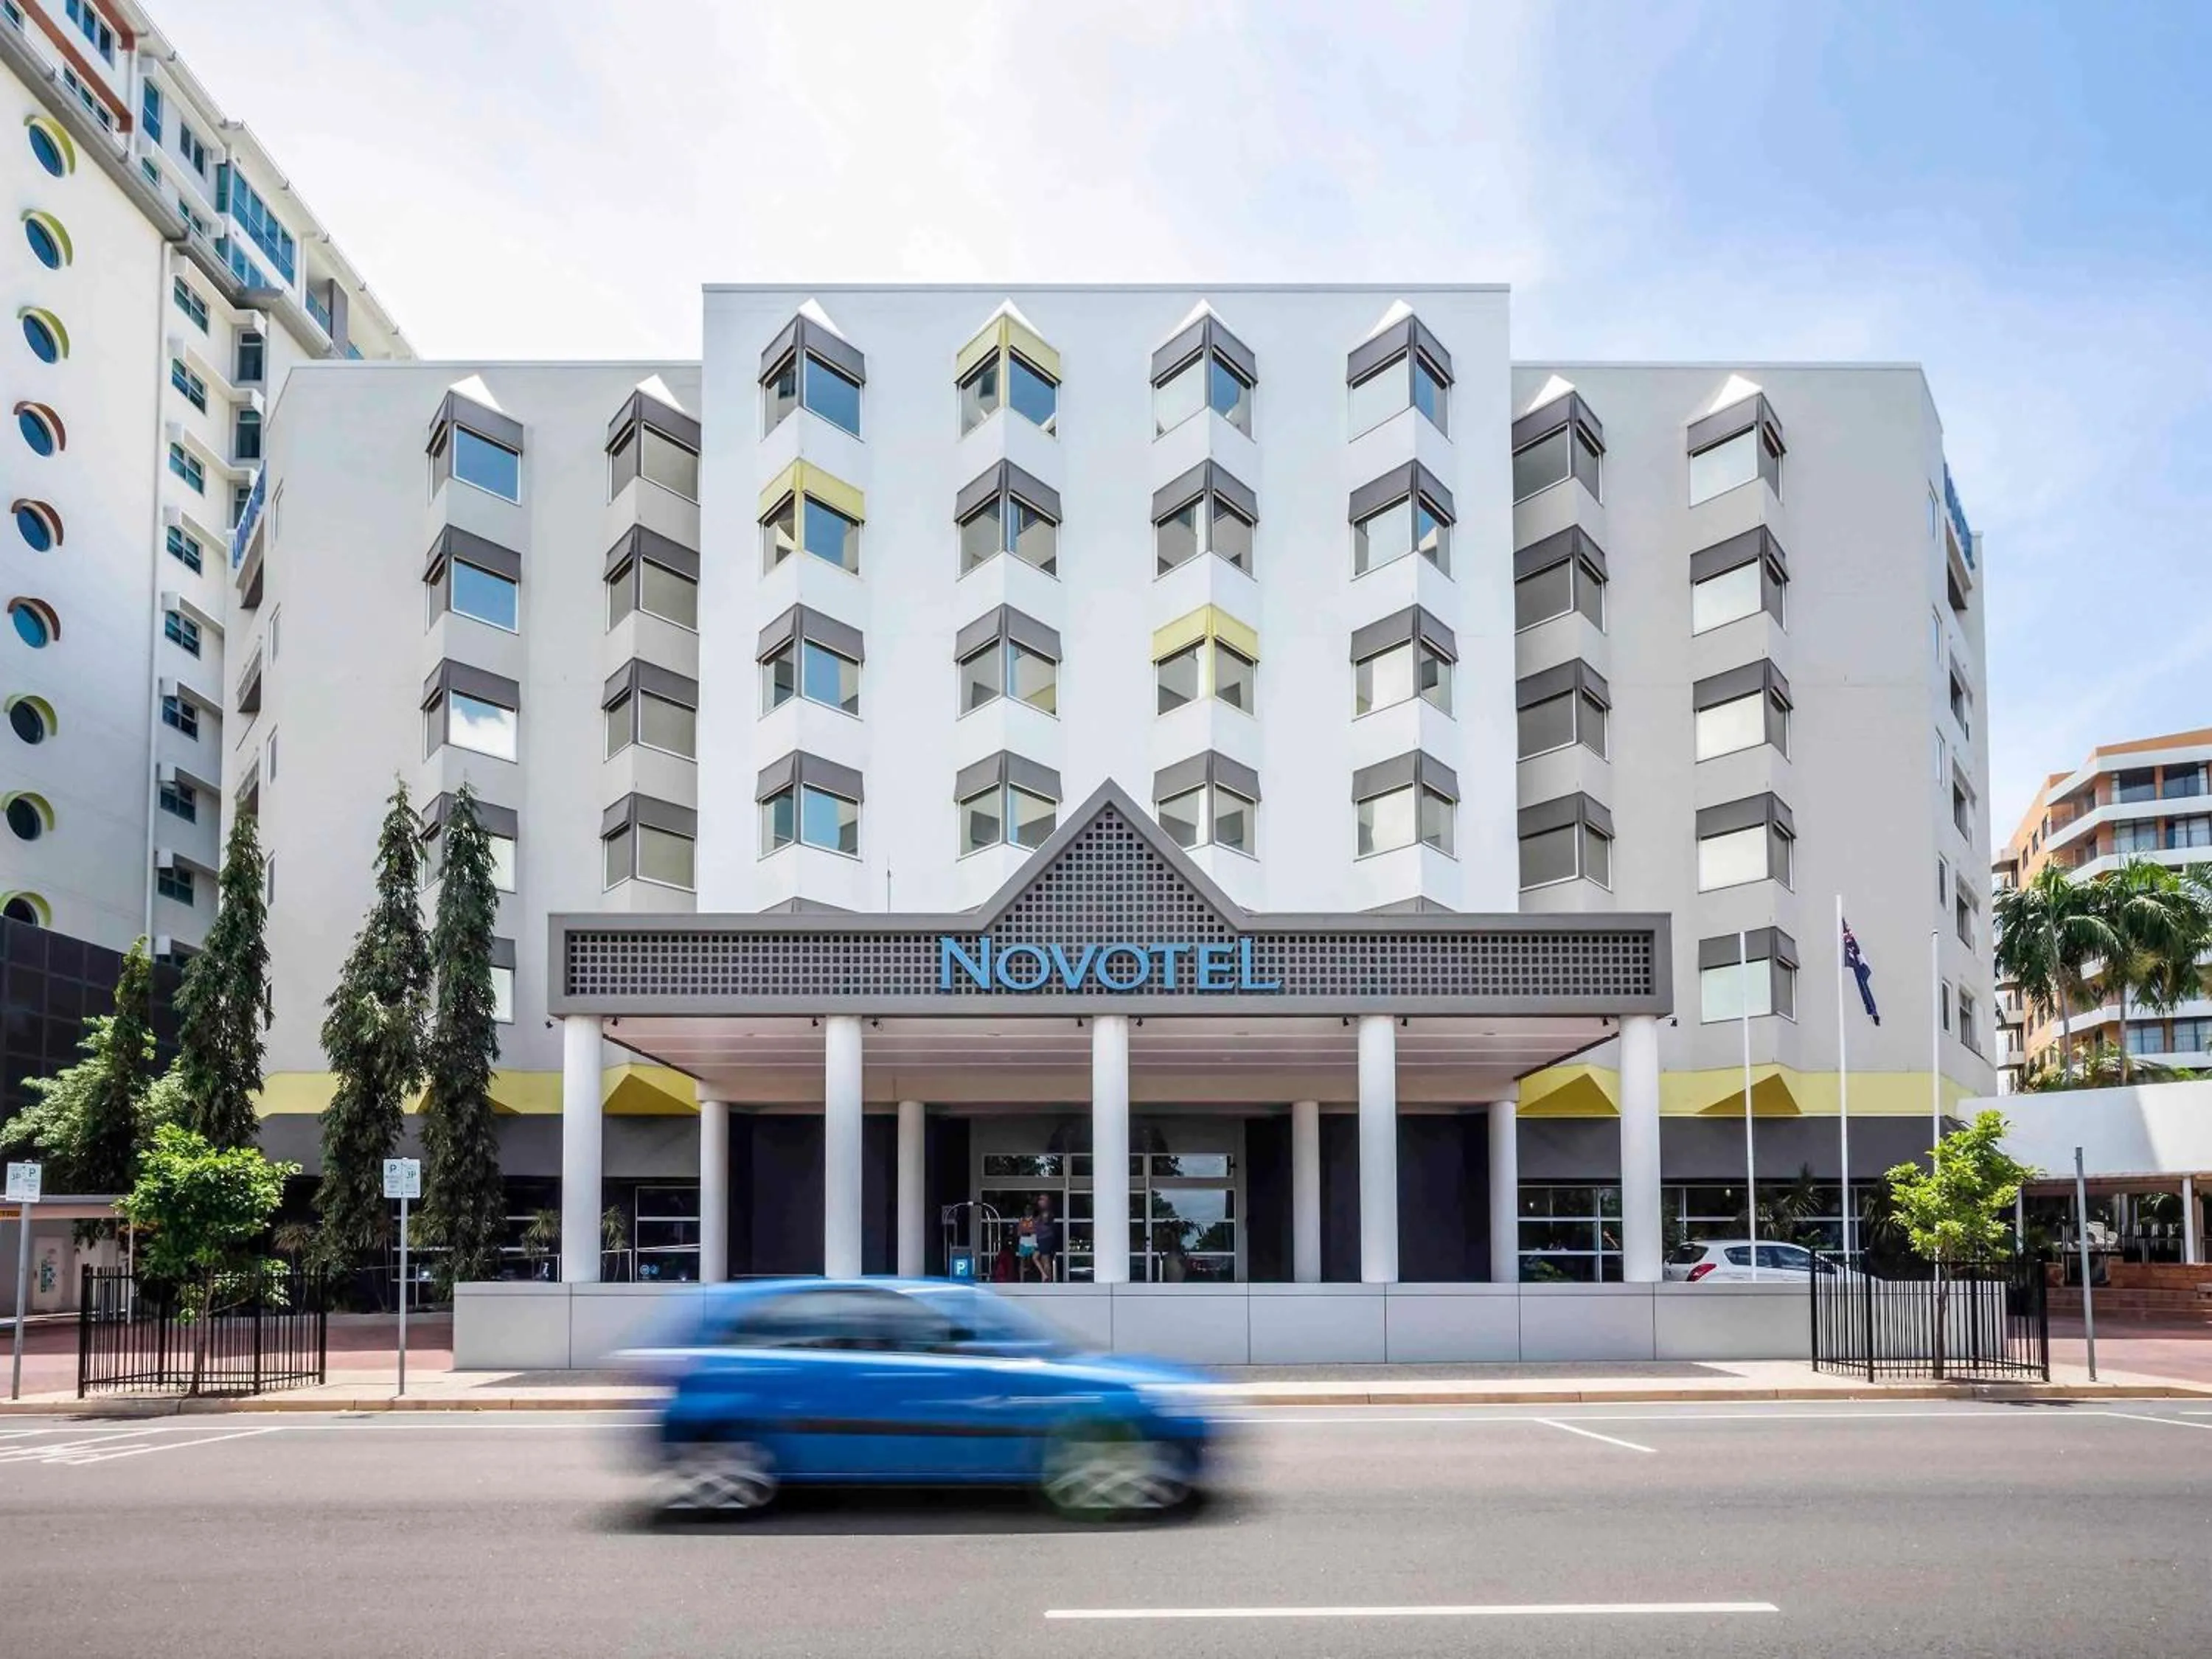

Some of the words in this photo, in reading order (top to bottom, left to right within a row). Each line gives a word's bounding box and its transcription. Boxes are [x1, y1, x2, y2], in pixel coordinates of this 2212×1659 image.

[940, 937, 1281, 990] NOVOTEL
[29, 1167, 36, 1178] P
[956, 1262, 965, 1275] P
